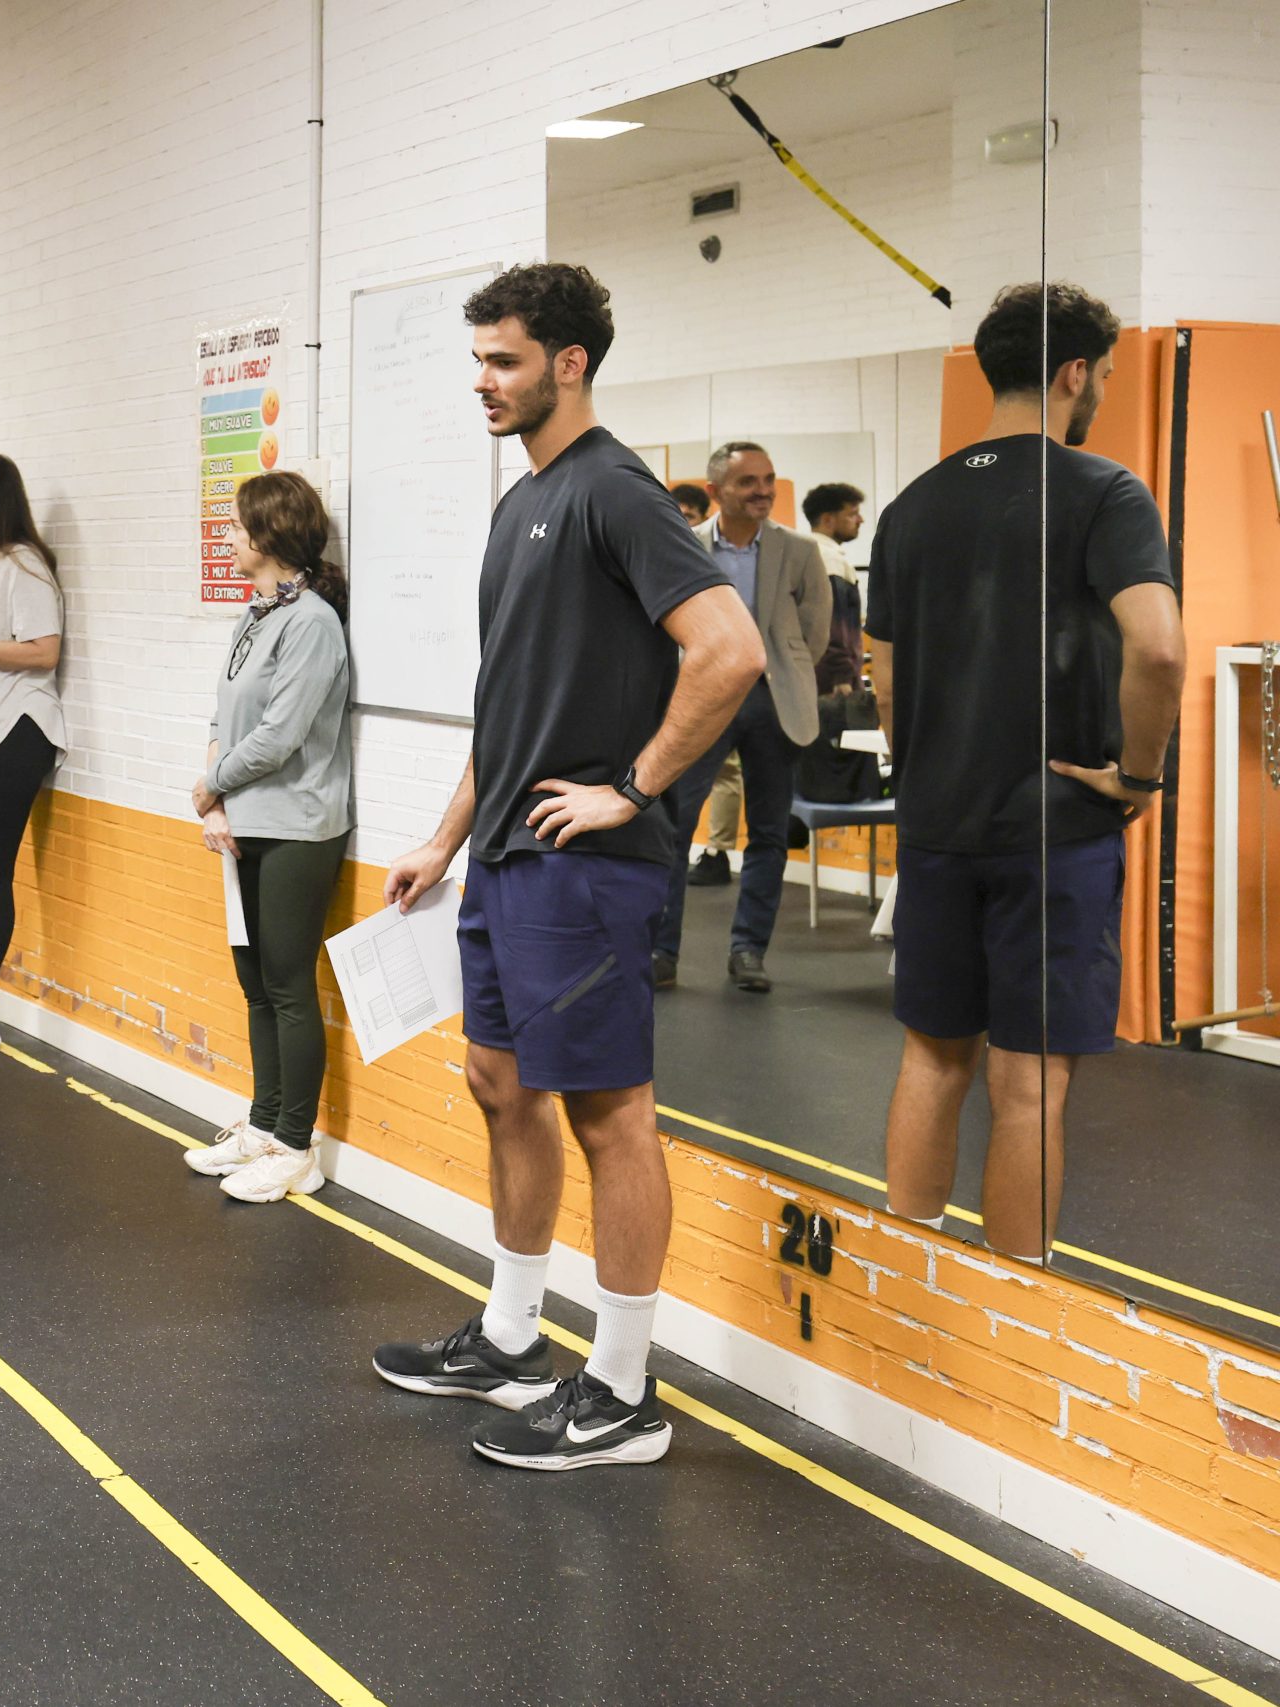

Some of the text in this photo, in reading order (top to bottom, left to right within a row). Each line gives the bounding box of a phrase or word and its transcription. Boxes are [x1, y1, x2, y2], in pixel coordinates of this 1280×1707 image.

[209, 417, 223, 432] MUY
[226, 414, 253, 430] SUAVE
[209, 458, 233, 474] SUAVE
[202, 523, 208, 537] 7
[203, 544, 232, 558] 8 DURO
[203, 565, 209, 578] 9
[212, 566, 228, 578] MUY
[203, 585, 246, 600] 10 EXTREMO
